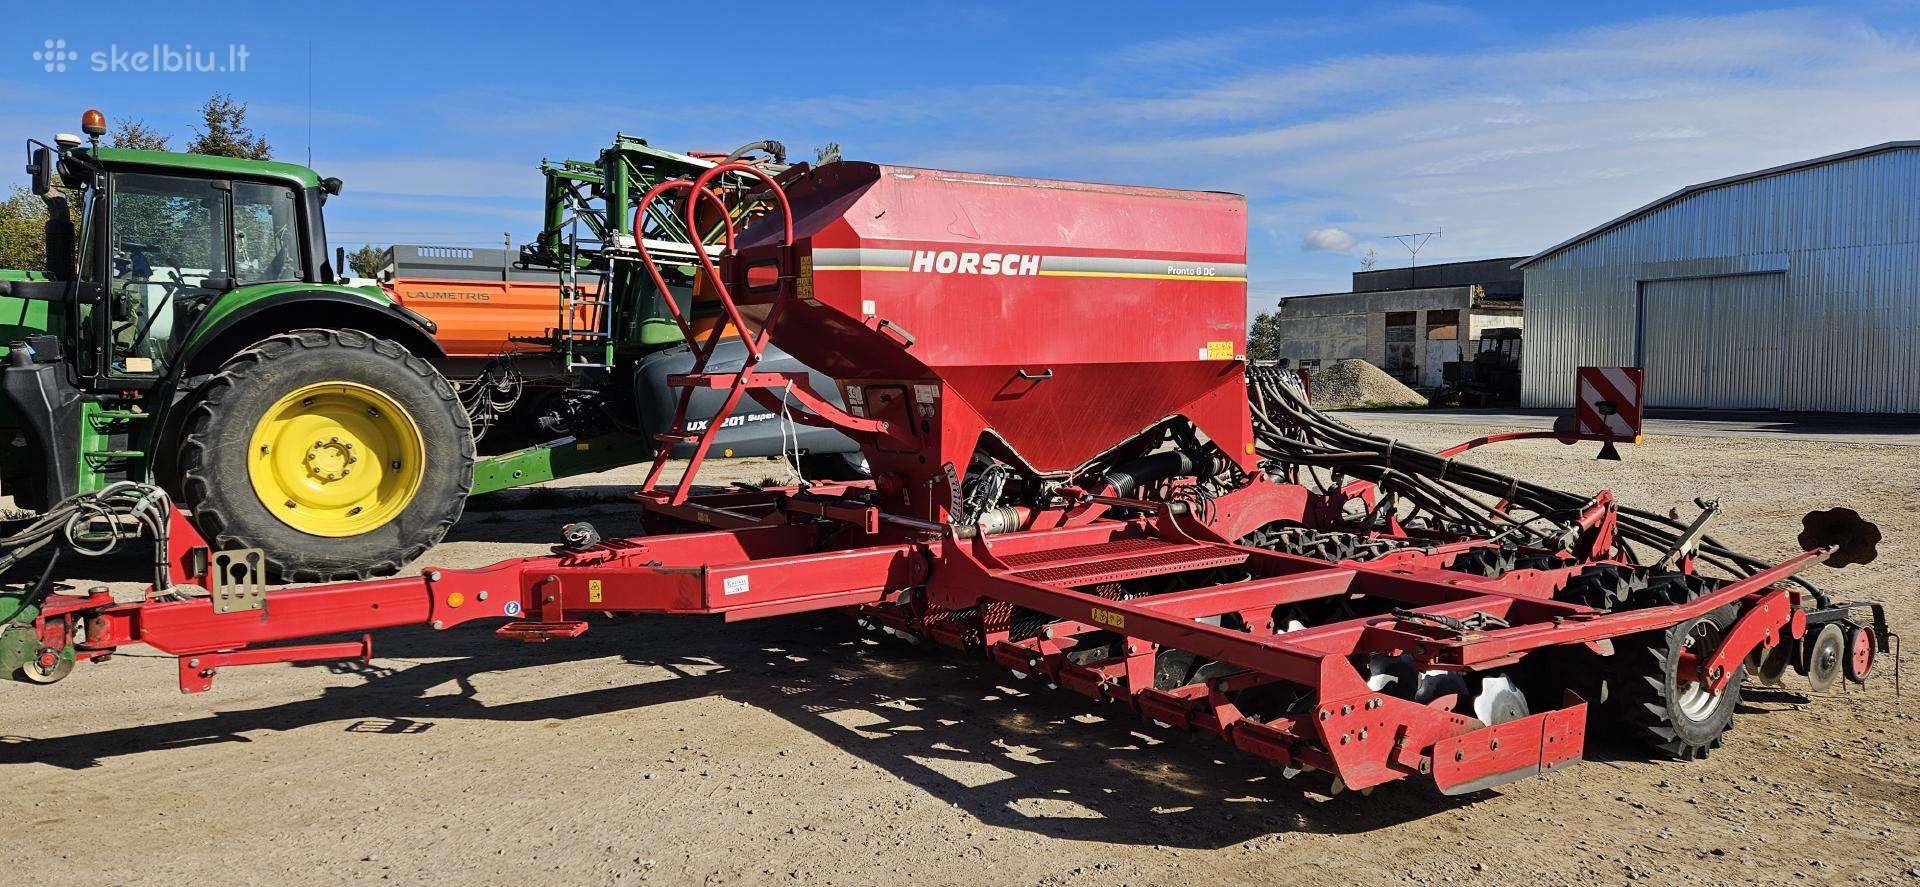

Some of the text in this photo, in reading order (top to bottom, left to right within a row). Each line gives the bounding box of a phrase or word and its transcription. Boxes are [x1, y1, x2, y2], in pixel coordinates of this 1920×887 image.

[912, 250, 1040, 276] HORSCH
[1167, 265, 1195, 276] Pronto
[1203, 267, 1216, 277] DC
[405, 291, 490, 301] LAUMETRIS
[686, 412, 776, 432] UX 201 Super
